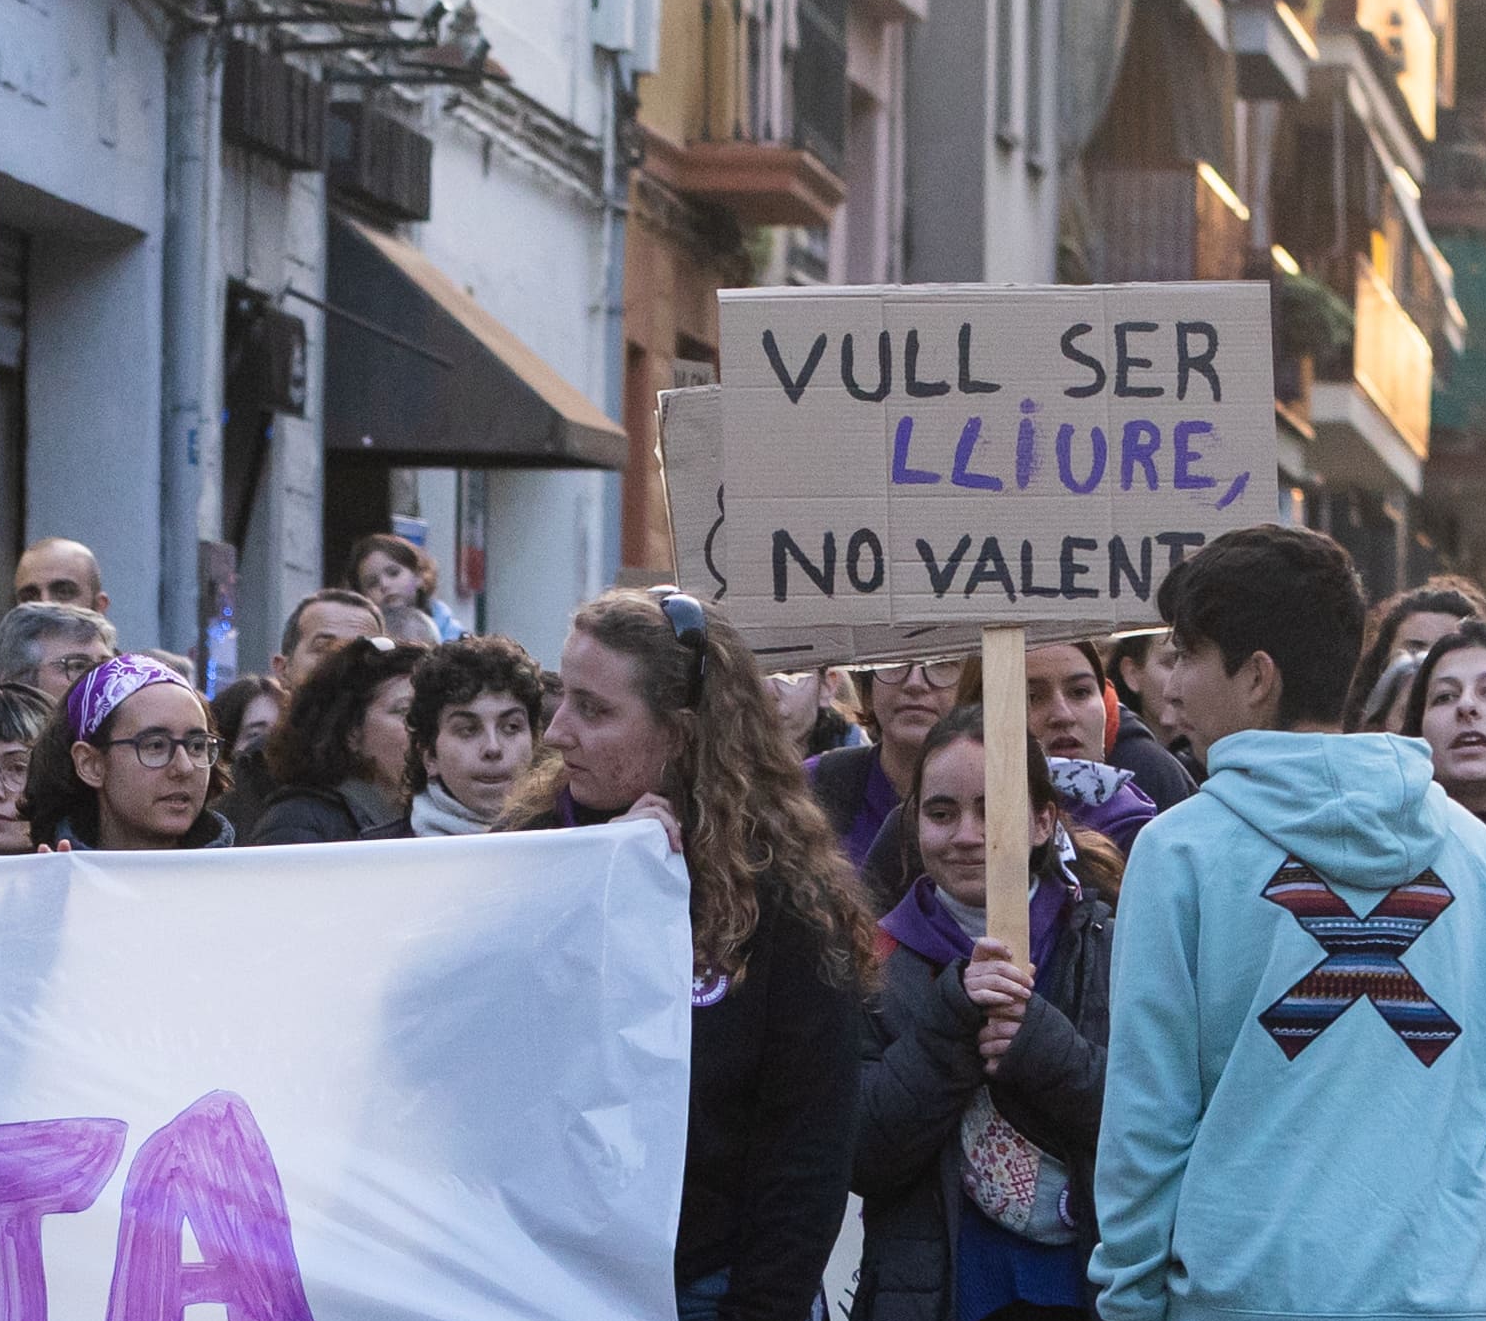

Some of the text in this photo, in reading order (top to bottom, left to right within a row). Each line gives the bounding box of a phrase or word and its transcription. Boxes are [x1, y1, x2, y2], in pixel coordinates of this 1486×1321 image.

[762, 321, 1222, 405] VULL SER
[772, 529, 885, 603] NO
